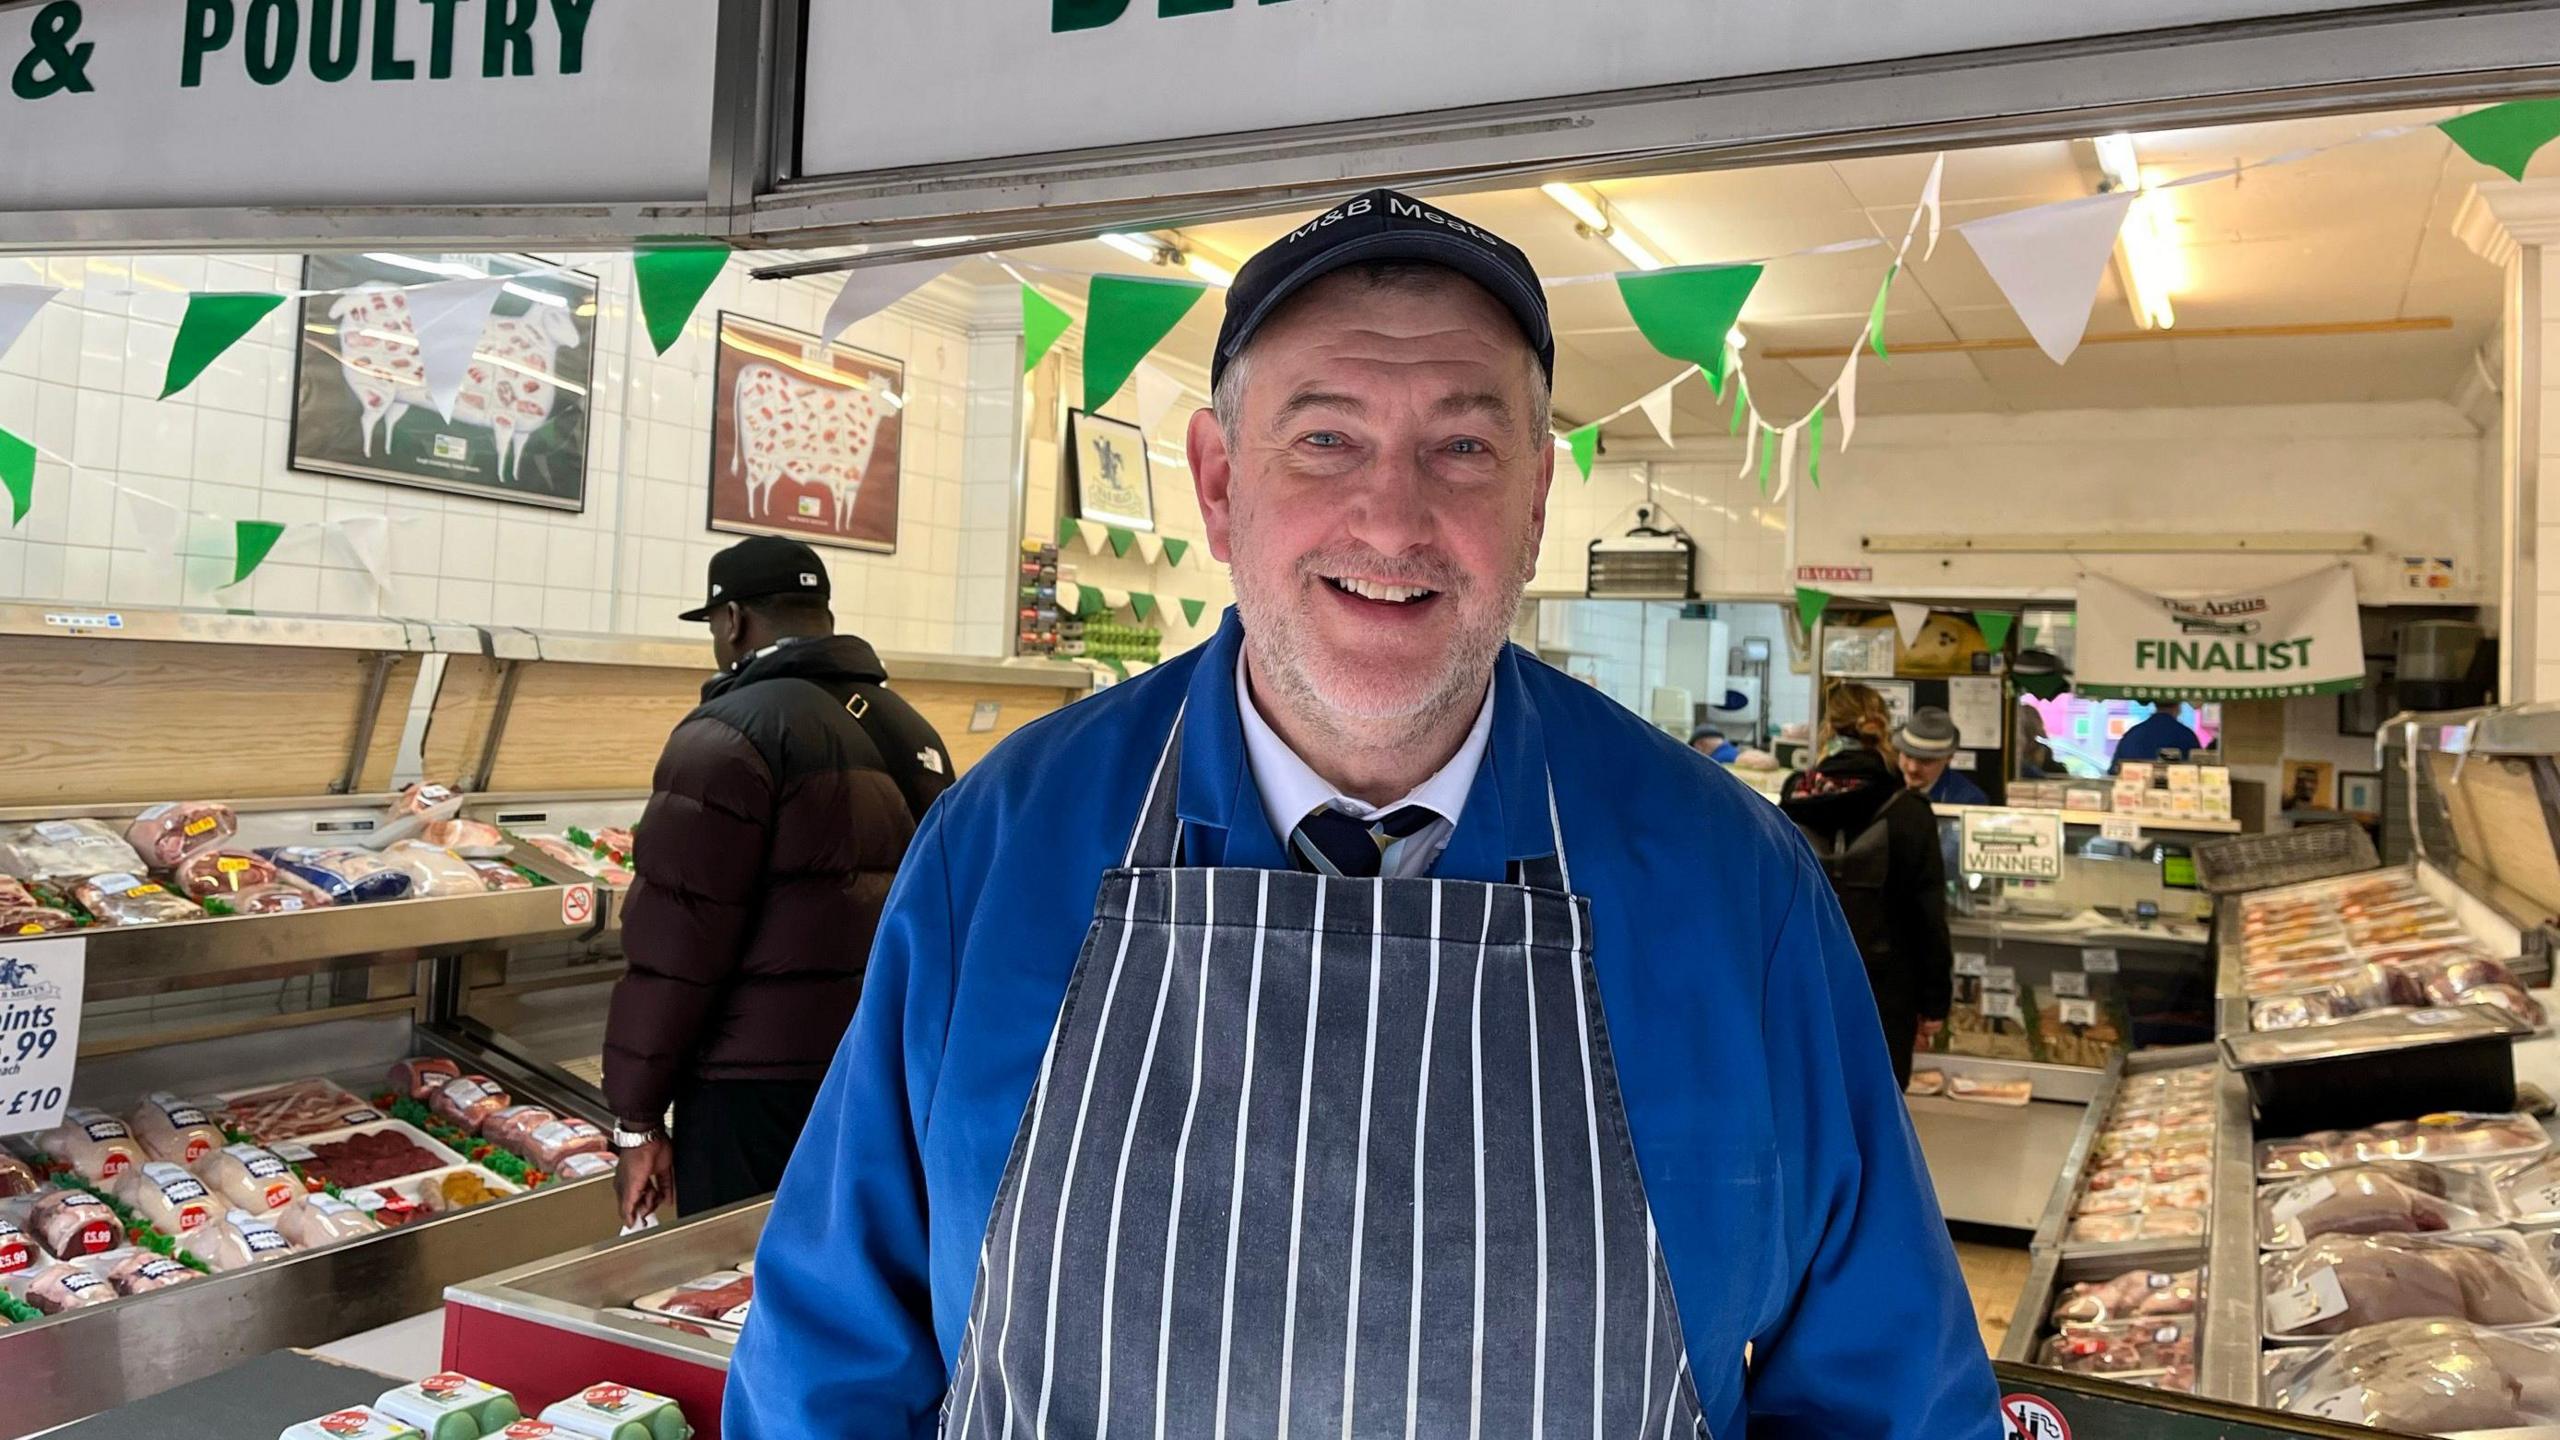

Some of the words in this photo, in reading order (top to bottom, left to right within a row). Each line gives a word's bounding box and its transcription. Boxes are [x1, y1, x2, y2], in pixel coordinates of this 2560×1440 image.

[11, 0, 95, 99] &
[180, 0, 599, 87] POULTRY
[1288, 199, 1372, 243] M&B
[1390, 198, 1498, 246] Meats
[2202, 598, 2266, 615] Argus
[2136, 637, 2314, 673] FINALIST
[1967, 852, 2054, 873] WINNER
[0, 1003, 56, 1032] ints
[0, 1064, 20, 1077] ach
[7, 1087, 62, 1115] £10
[83, 1230, 111, 1243] £5.99
